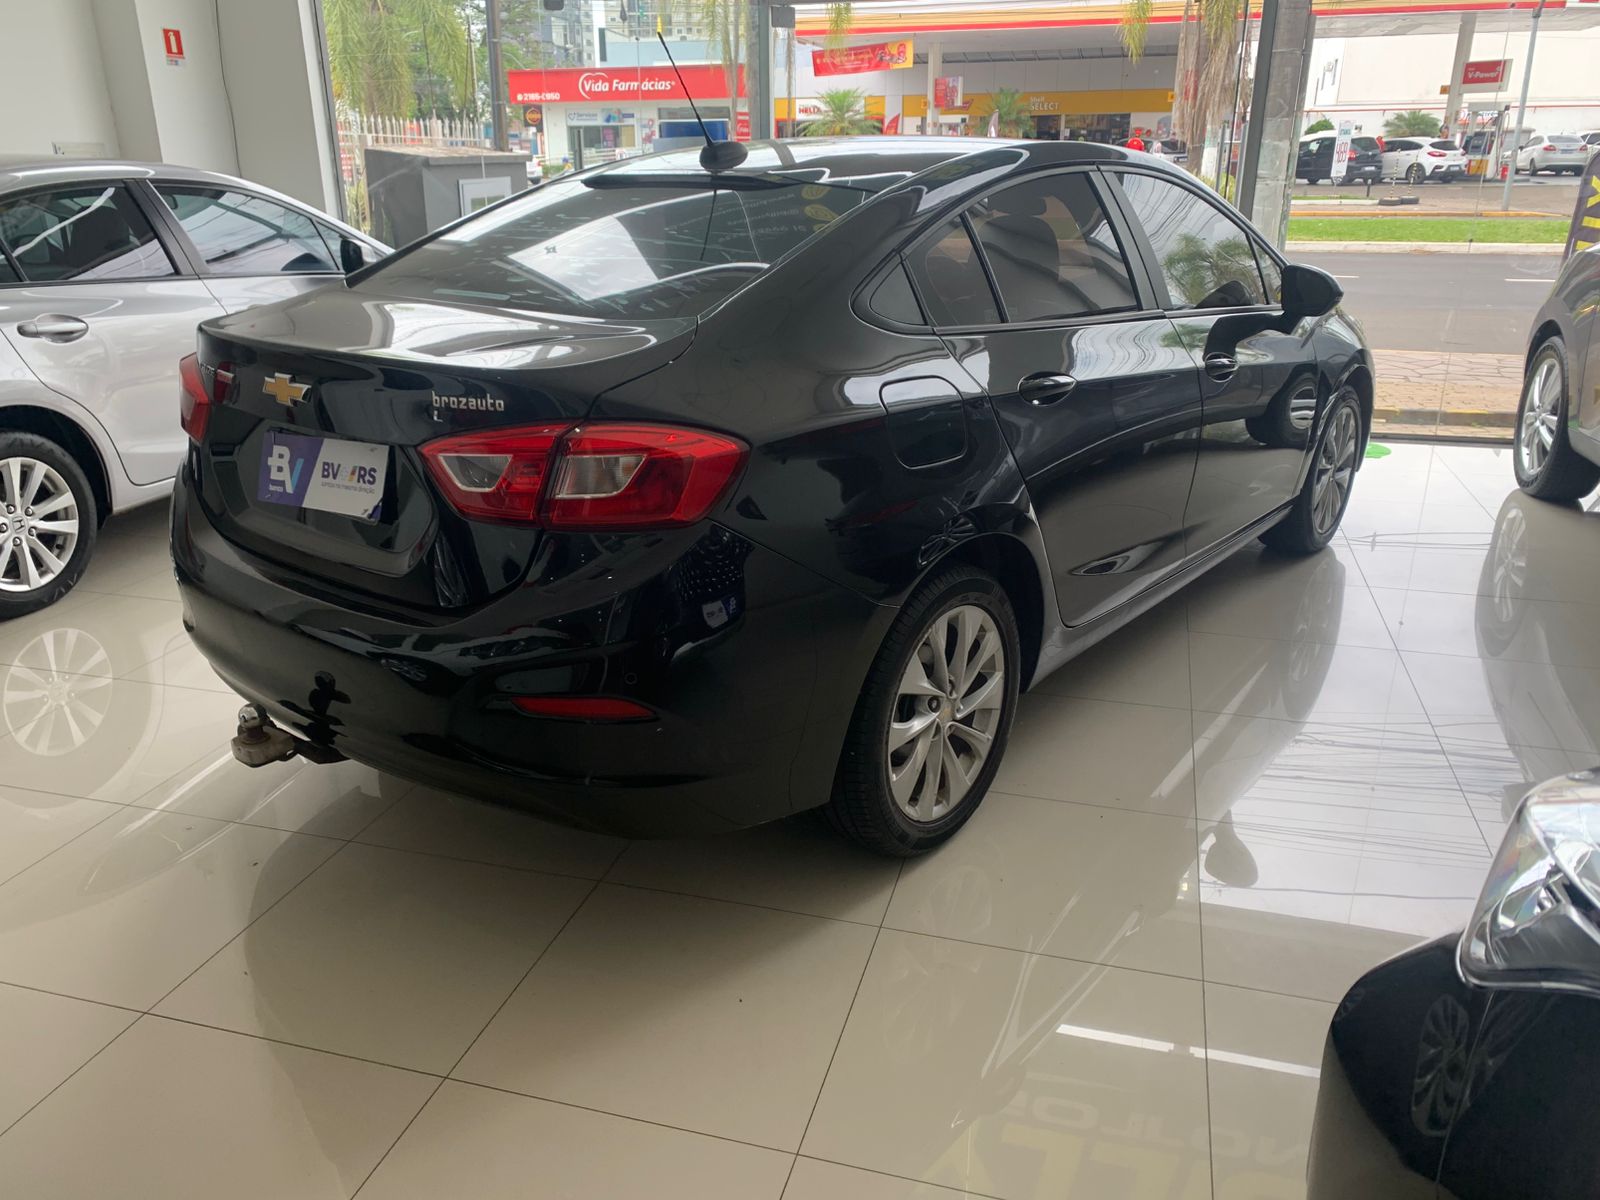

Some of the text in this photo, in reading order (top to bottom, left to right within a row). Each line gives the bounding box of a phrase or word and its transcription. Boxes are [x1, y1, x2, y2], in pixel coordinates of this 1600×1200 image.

[583, 79, 609, 91] Vida
[1030, 102, 1060, 111] SELECT
[431, 390, 505, 412] brozauto
[321, 461, 378, 486] BV RS
